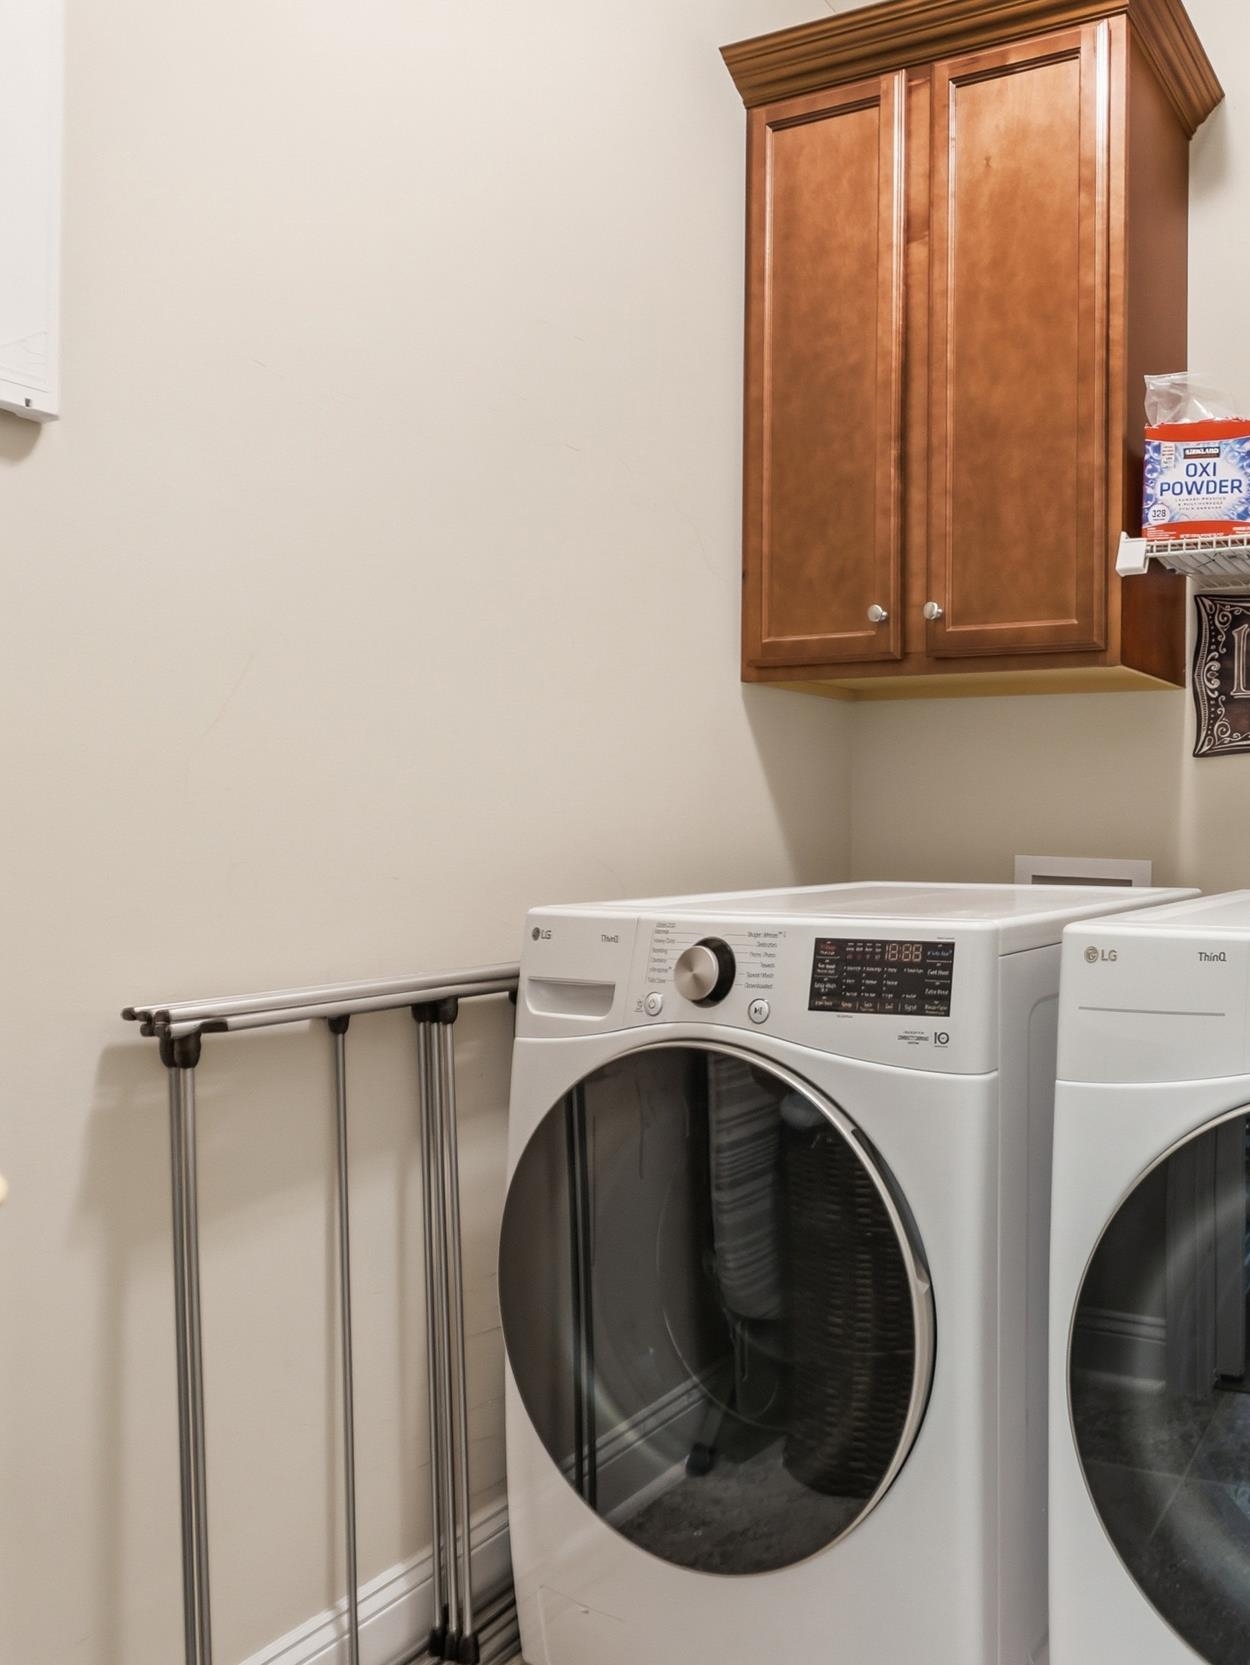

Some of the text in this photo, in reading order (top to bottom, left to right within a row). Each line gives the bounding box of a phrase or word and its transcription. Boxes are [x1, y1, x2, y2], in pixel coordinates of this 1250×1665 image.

[1186, 462, 1217, 477] OXI
[1160, 479, 1243, 496] POWDER
[1151, 509, 1167, 518] 328
[1100, 949, 1118, 962] LG
[1197, 951, 1227, 962] ThinQ
